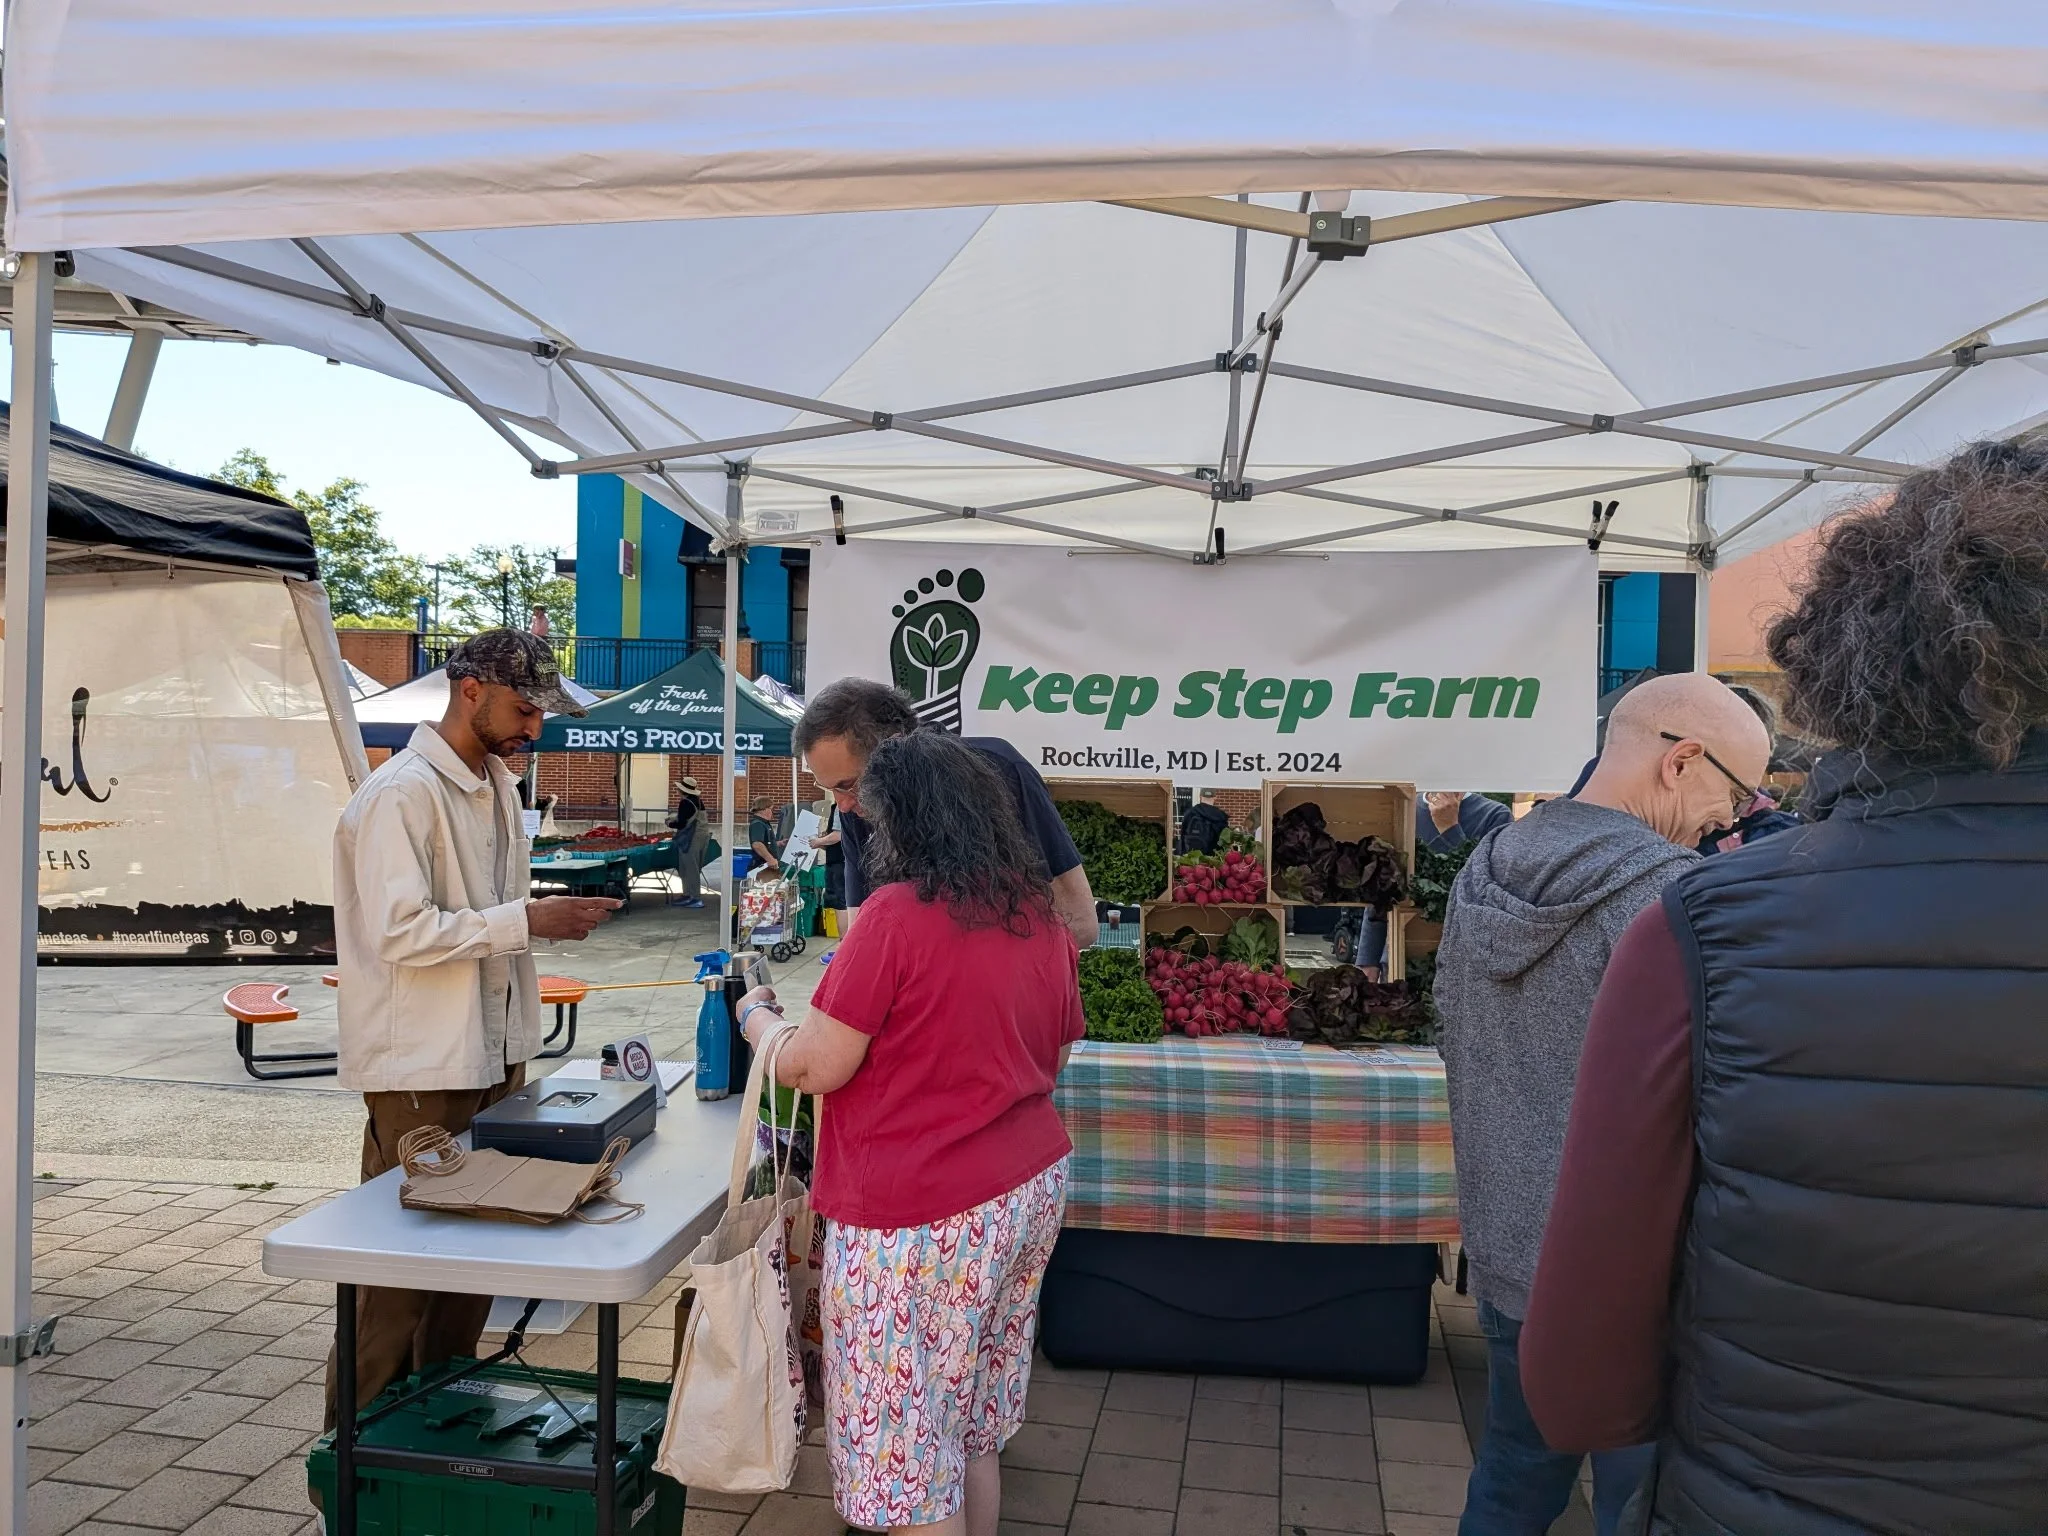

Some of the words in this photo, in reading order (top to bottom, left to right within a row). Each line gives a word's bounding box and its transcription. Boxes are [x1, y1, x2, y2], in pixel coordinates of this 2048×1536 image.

[660, 685, 708, 700] Fresh
[978, 665, 1159, 730] Keep
[1173, 669, 1333, 733] Step
[1349, 672, 1540, 718] Farm
[629, 699, 655, 714] off
[654, 700, 681, 712] the
[680, 702, 725, 715] farm
[565, 726, 638, 748] BEN'S
[1040, 746, 1161, 773] Rockville,
[1166, 751, 1208, 770] MD
[1226, 752, 1272, 772] Est.
[1278, 752, 1342, 773] 2024
[38, 849, 91, 870] EAS
[38, 931, 89, 945] ineteas
[112, 930, 210, 946] #pearlfineteas
[454, 1464, 489, 1474] LIFETIME
